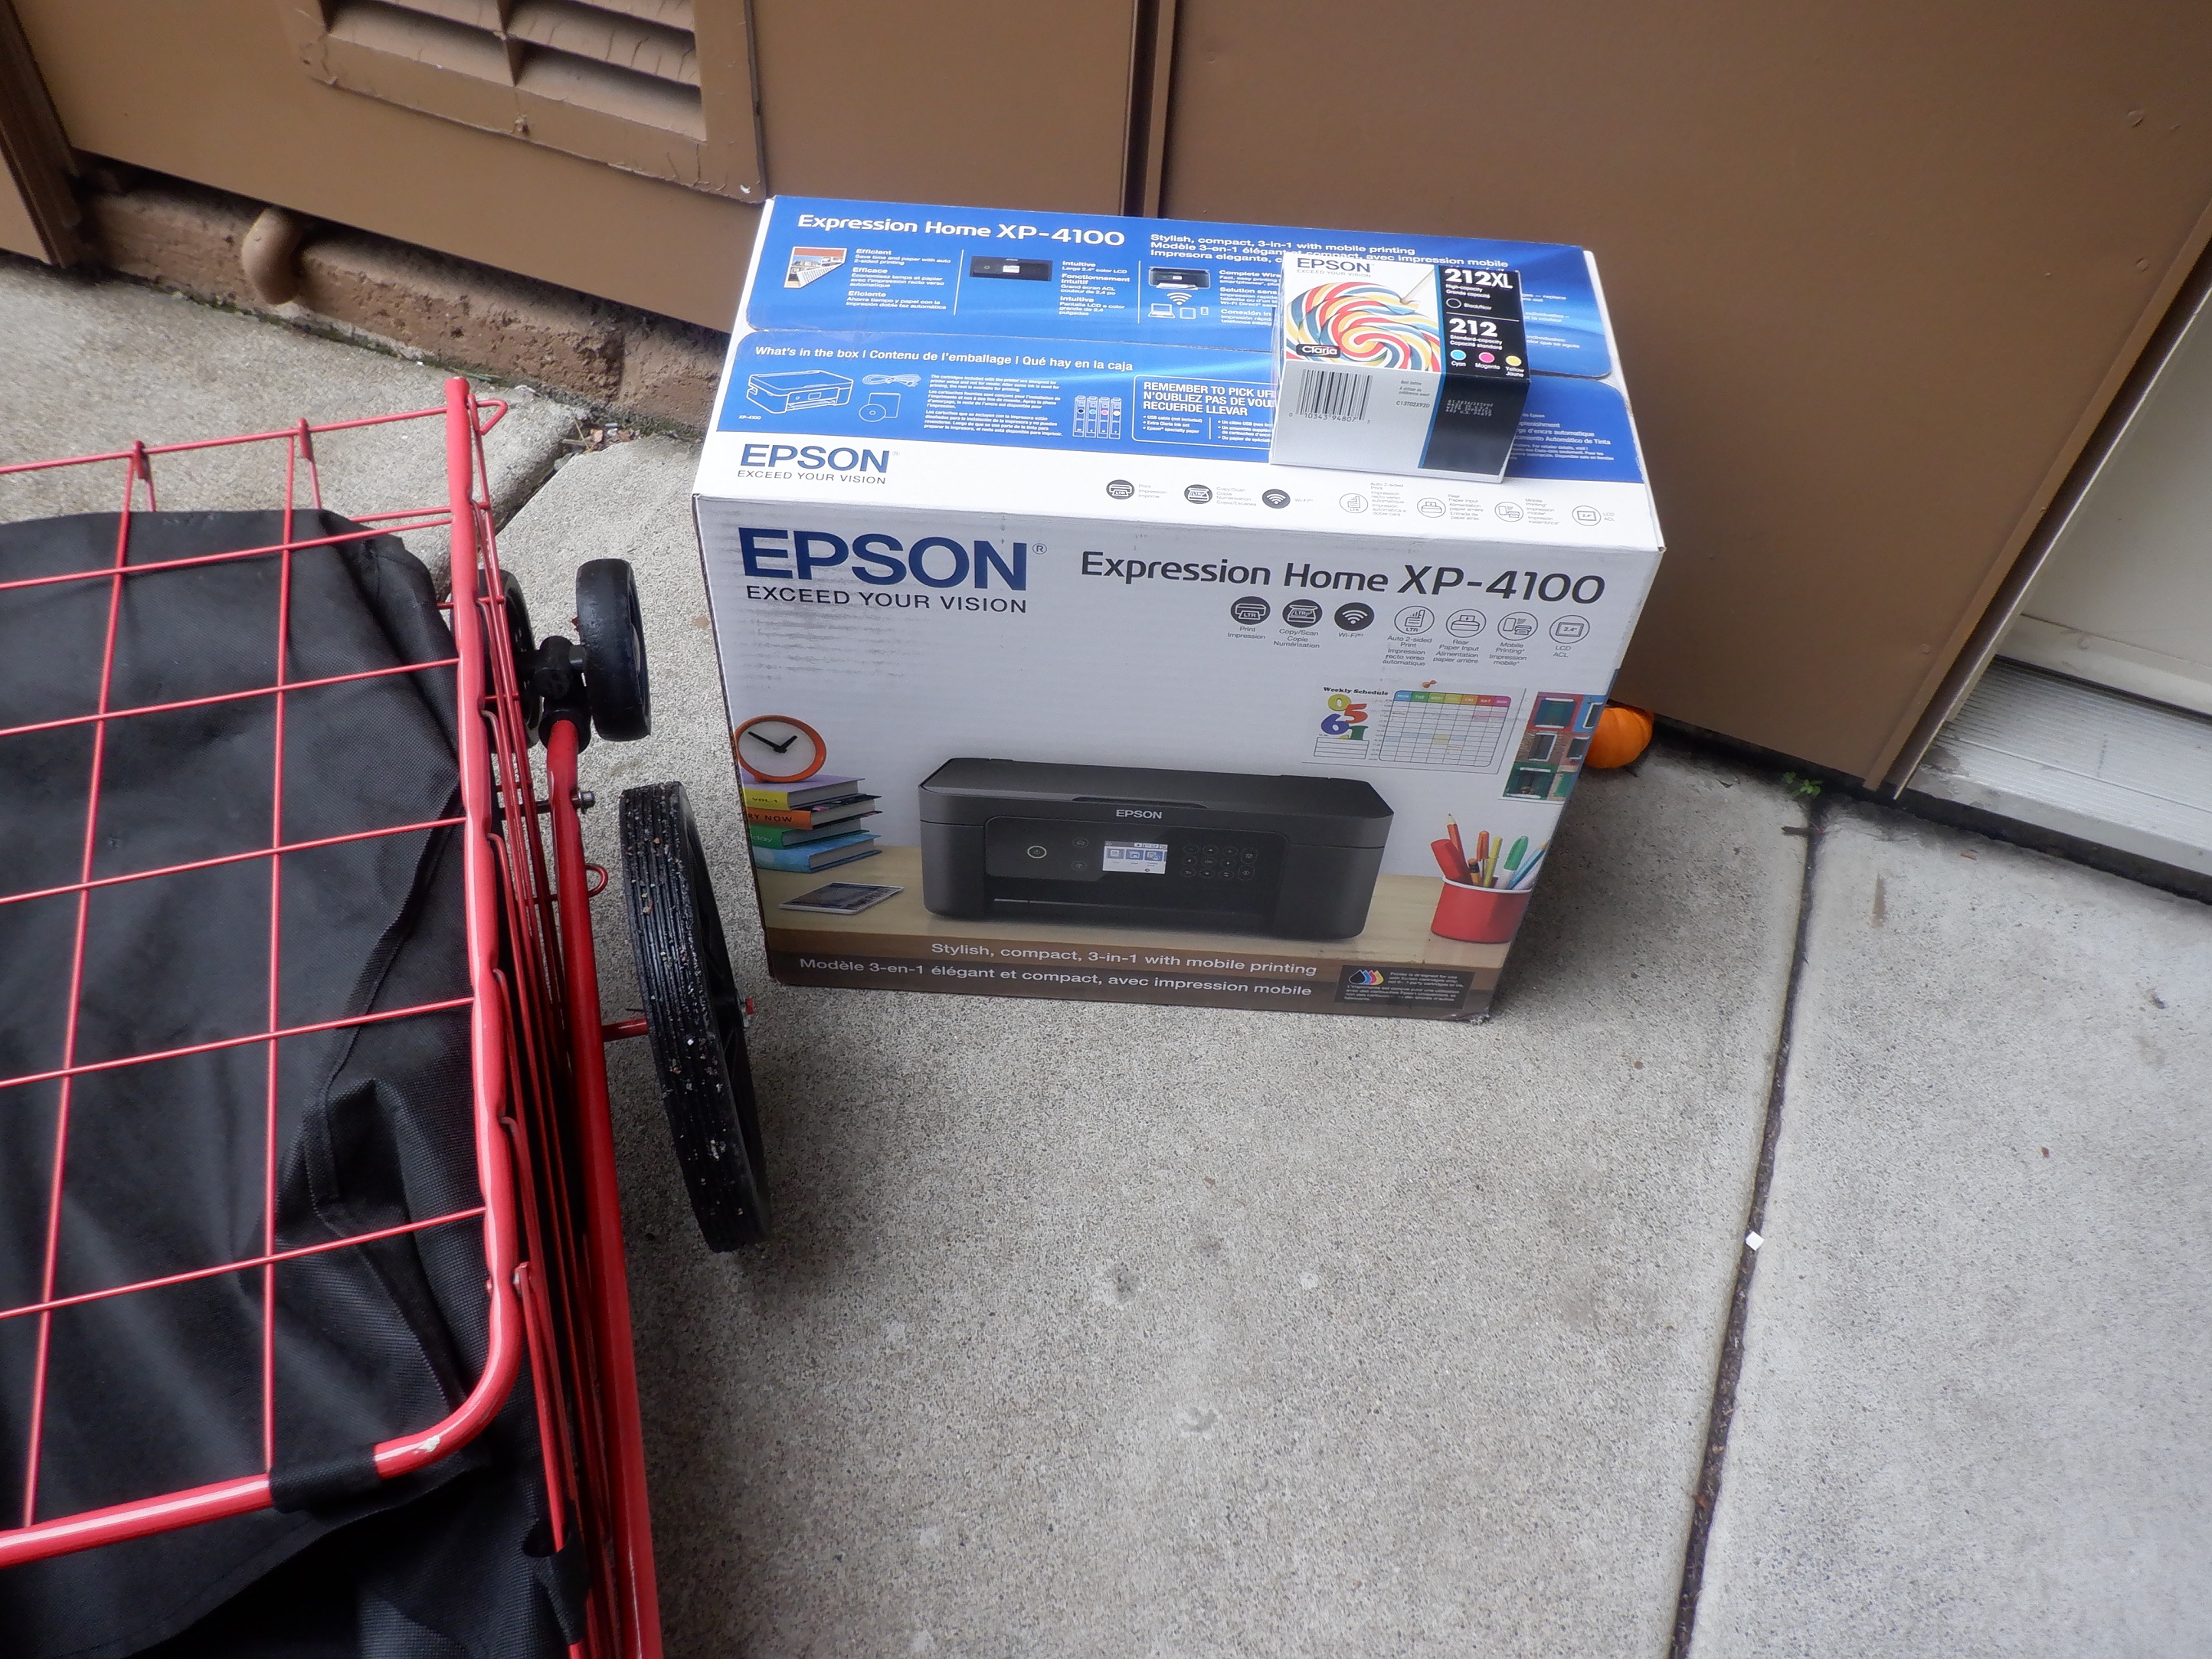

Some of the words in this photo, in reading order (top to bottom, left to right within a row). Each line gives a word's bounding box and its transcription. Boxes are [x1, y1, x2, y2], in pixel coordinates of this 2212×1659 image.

[797, 214, 918, 233] Expression
[925, 221, 991, 237] Home
[996, 222, 1125, 246] XP-4100
[1151, 234, 1194, 244] Stylish,
[1198, 237, 1254, 247] compact,
[1369, 246, 1415, 255] printing
[1151, 241, 1196, 250] Modèle
[1200, 244, 1237, 253] 3-en-1
[1399, 255, 1464, 266] impression
[1468, 259, 1508, 267] mobile
[1151, 250, 1212, 260] Impresora
[1216, 254, 1274, 263] elegante,
[1297, 257, 1371, 273] EPSON
[1062, 273, 1131, 282] Fonctionnement
[1445, 268, 1513, 289] 212XL
[1445, 284, 1483, 293] High-capacity
[1449, 318, 1498, 337] 212
[1450, 335, 1502, 345] Standard-capacity
[755, 346, 797, 357] What's
[800, 348, 811, 357] in
[814, 349, 834, 358] the
[837, 350, 859, 358] box
[869, 351, 920, 360] Contenu
[923, 352, 939, 361] de
[941, 352, 1012, 365] l'emballage
[1023, 355, 1046, 367] Qué
[1049, 357, 1071, 370] hay
[1094, 360, 1104, 369] la
[1108, 362, 1133, 371] caja
[1302, 346, 1337, 355] Claria
[1143, 391, 1203, 403] N'OUBLIEZ
[1206, 395, 1227, 405] PAS
[1230, 397, 1245, 406] DE
[1144, 382, 1208, 394] REMEMBER
[1211, 385, 1225, 394] TO
[1229, 387, 1255, 397] PICK
[1143, 401, 1203, 413] RECUERDE
[1206, 405, 1248, 416] LLEVAR
[740, 443, 890, 473] EPSON
[738, 470, 792, 479] EXCEED
[797, 472, 835, 481] YOUR
[840, 475, 886, 484] VISION
[738, 527, 1028, 591] EPSON
[1081, 551, 1270, 585] Expression
[1284, 562, 1388, 592] Home
[1396, 564, 1605, 604] XP-4100
[747, 585, 850, 604] EXCEED
[859, 591, 931, 609] YOUR
[941, 595, 1026, 613] VISION
[1274, 640, 1320, 649] Numérisation
[1327, 694, 1351, 712] 0
[1343, 703, 1367, 724] 5
[1320, 713, 1350, 735] 6
[1116, 809, 1162, 820] EPSON
[931, 944, 994, 957] Stylish,
[1000, 948, 1081, 962] compact,
[1088, 953, 1136, 964] 3-in-1
[1144, 956, 1180, 965] with
[1186, 958, 1245, 970] mobile
[1250, 963, 1317, 976] printing
[800, 958, 864, 971] Modèle
[869, 963, 923, 974] 3-en-1
[931, 965, 995, 979] élégant
[1000, 970, 1016, 979] et
[1022, 972, 1102, 985] compact,
[1108, 977, 1149, 987] avec
[1153, 977, 1248, 992] impression
[1254, 984, 1311, 996] mobile
